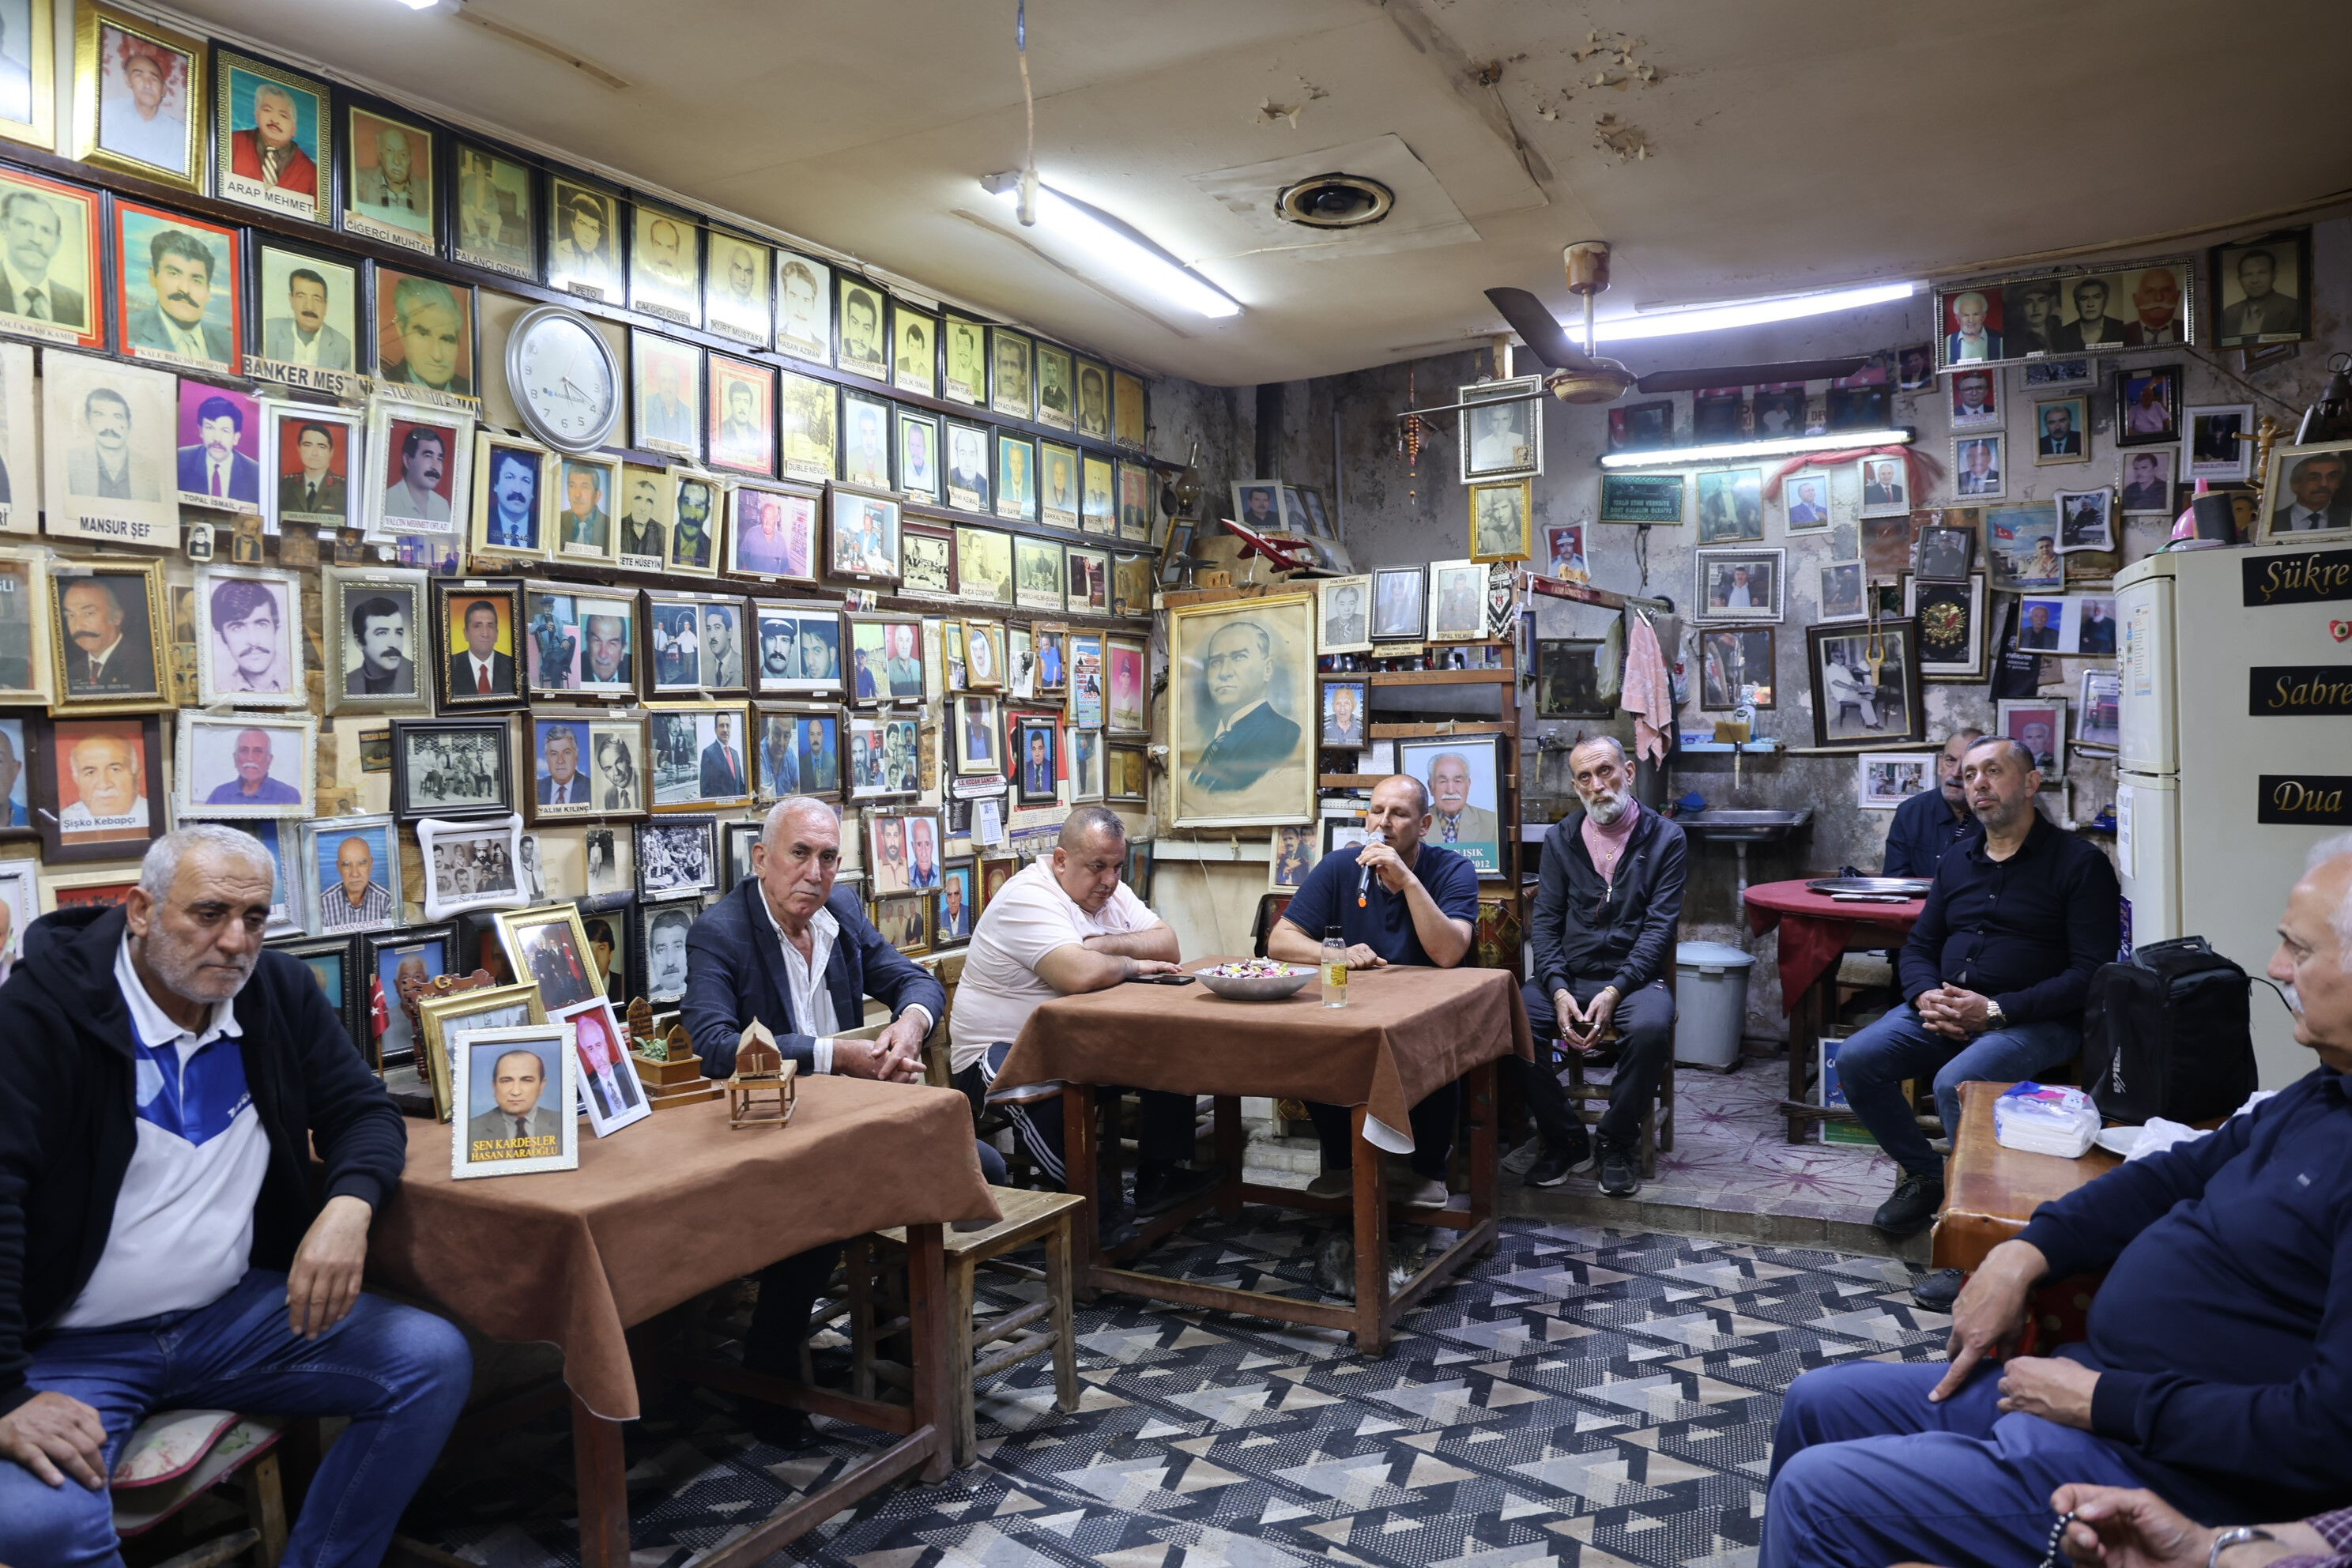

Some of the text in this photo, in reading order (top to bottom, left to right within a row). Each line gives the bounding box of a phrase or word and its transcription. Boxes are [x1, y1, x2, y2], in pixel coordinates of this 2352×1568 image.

[228, 181, 314, 214] ARAP MEHMET
[575, 285, 597, 299] PETO
[243, 356, 308, 386] BANKER
[530, 389, 538, 399] 8
[543, 408, 551, 418] 7
[590, 405, 596, 414] 4
[561, 418, 568, 428] 6
[578, 416, 585, 427] 5
[183, 493, 209, 505] TOPAL
[210, 497, 236, 511] İSMAİL
[80, 516, 152, 540] MANSUR ŞEF
[634, 556, 662, 569] HÜSEYİN
[2260, 553, 2352, 602] Şükre
[2274, 781, 2343, 812] Dua
[63, 816, 136, 829] Şişko Kebapçı
[1463, 848, 1484, 862] IŞIK
[473, 1135, 556, 1152] ŞEN KARDEŞLER
[471, 1144, 558, 1161] HASAN KARAOĞLU
